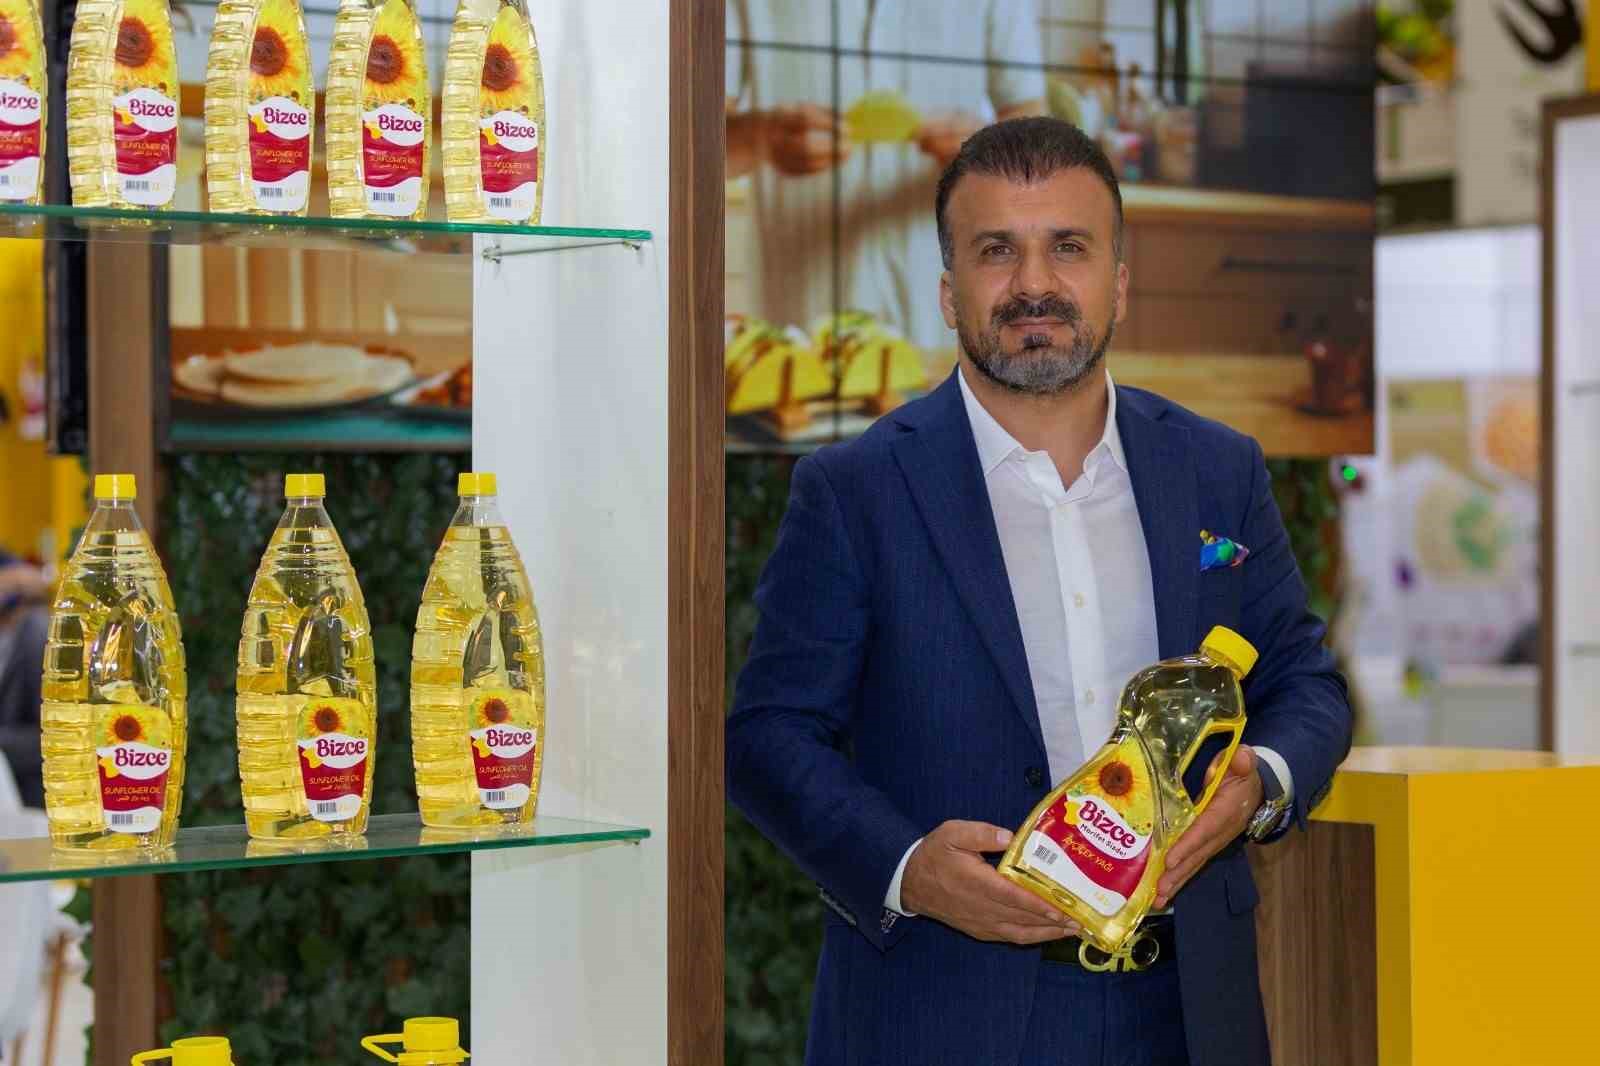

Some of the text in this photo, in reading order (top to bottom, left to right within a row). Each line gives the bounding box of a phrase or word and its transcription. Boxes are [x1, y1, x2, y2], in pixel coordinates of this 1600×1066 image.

[0, 92, 38, 109] izce
[129, 98, 174, 117] Bizce
[264, 107, 306, 125] Bizce
[378, 114, 422, 131] Bizce
[494, 121, 535, 138] Bizce
[486, 729, 532, 747] Bizce
[316, 739, 365, 757] Bizce
[114, 748, 167, 767] Bizce
[104, 785, 148, 794] SUNFLOWER
[1079, 800, 1136, 848] Bizce
